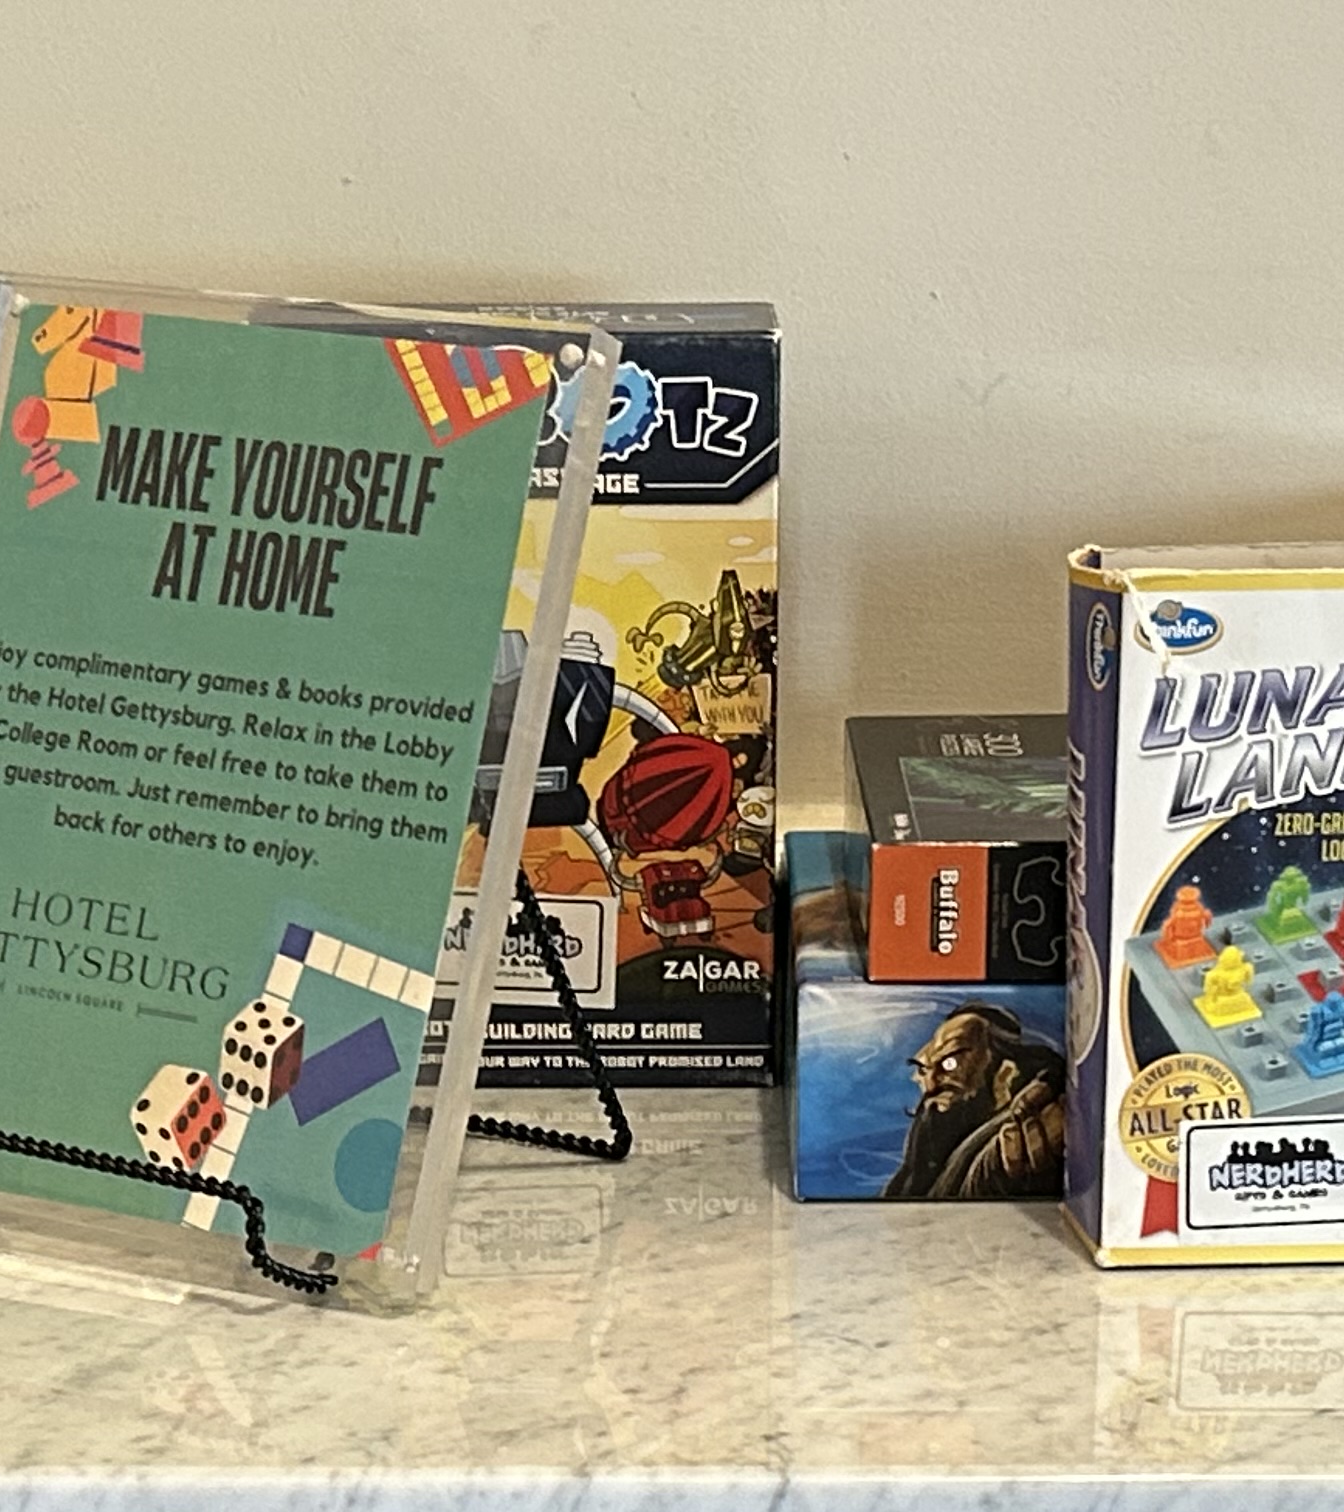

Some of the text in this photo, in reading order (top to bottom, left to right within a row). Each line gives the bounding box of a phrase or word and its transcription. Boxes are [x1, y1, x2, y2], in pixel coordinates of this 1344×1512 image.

[96, 424, 444, 537] MAKE YOURSELF
[151, 520, 347, 619] AT HOME
[33, 650, 192, 692] complimentary
[197, 672, 269, 698] games
[275, 676, 291, 699] &
[298, 678, 363, 709] books
[369, 694, 475, 724] provided
[737, 703, 763, 723] YOU
[8, 682, 41, 705] the
[47, 686, 106, 715] Hotel
[110, 694, 236, 737] Gettysburg.
[242, 713, 309, 743] Relax
[313, 722, 333, 746] in
[341, 726, 377, 751] the
[383, 731, 454, 767] Lobby
[77, 729, 139, 759] Room
[143, 744, 168, 764] or
[172, 743, 216, 770] feel
[221, 749, 267, 778] free
[274, 760, 297, 782] to
[304, 763, 354, 790] take
[361, 769, 417, 799] them
[425, 780, 448, 802] to
[4, 763, 120, 797] guestroom.
[127, 777, 171, 805] Just
[176, 787, 291, 821] remember
[296, 804, 319, 825] to
[325, 804, 384, 840] bring
[390, 814, 448, 844] them
[54, 804, 319, 870] back for others to enjoy.
[10, 887, 160, 942] HOTEL
[938, 868, 960, 957] Buffalo
[17, 983, 124, 1013] LINCOLN SQUARE
[484, 1022, 702, 1039] UILDING GAME
[508, 1055, 764, 1068] WAY TO PROMISED LAND
[1135, 1057, 1234, 1098] PLAYED THE MOST
[1129, 1097, 1243, 1137] ALL-STAR
